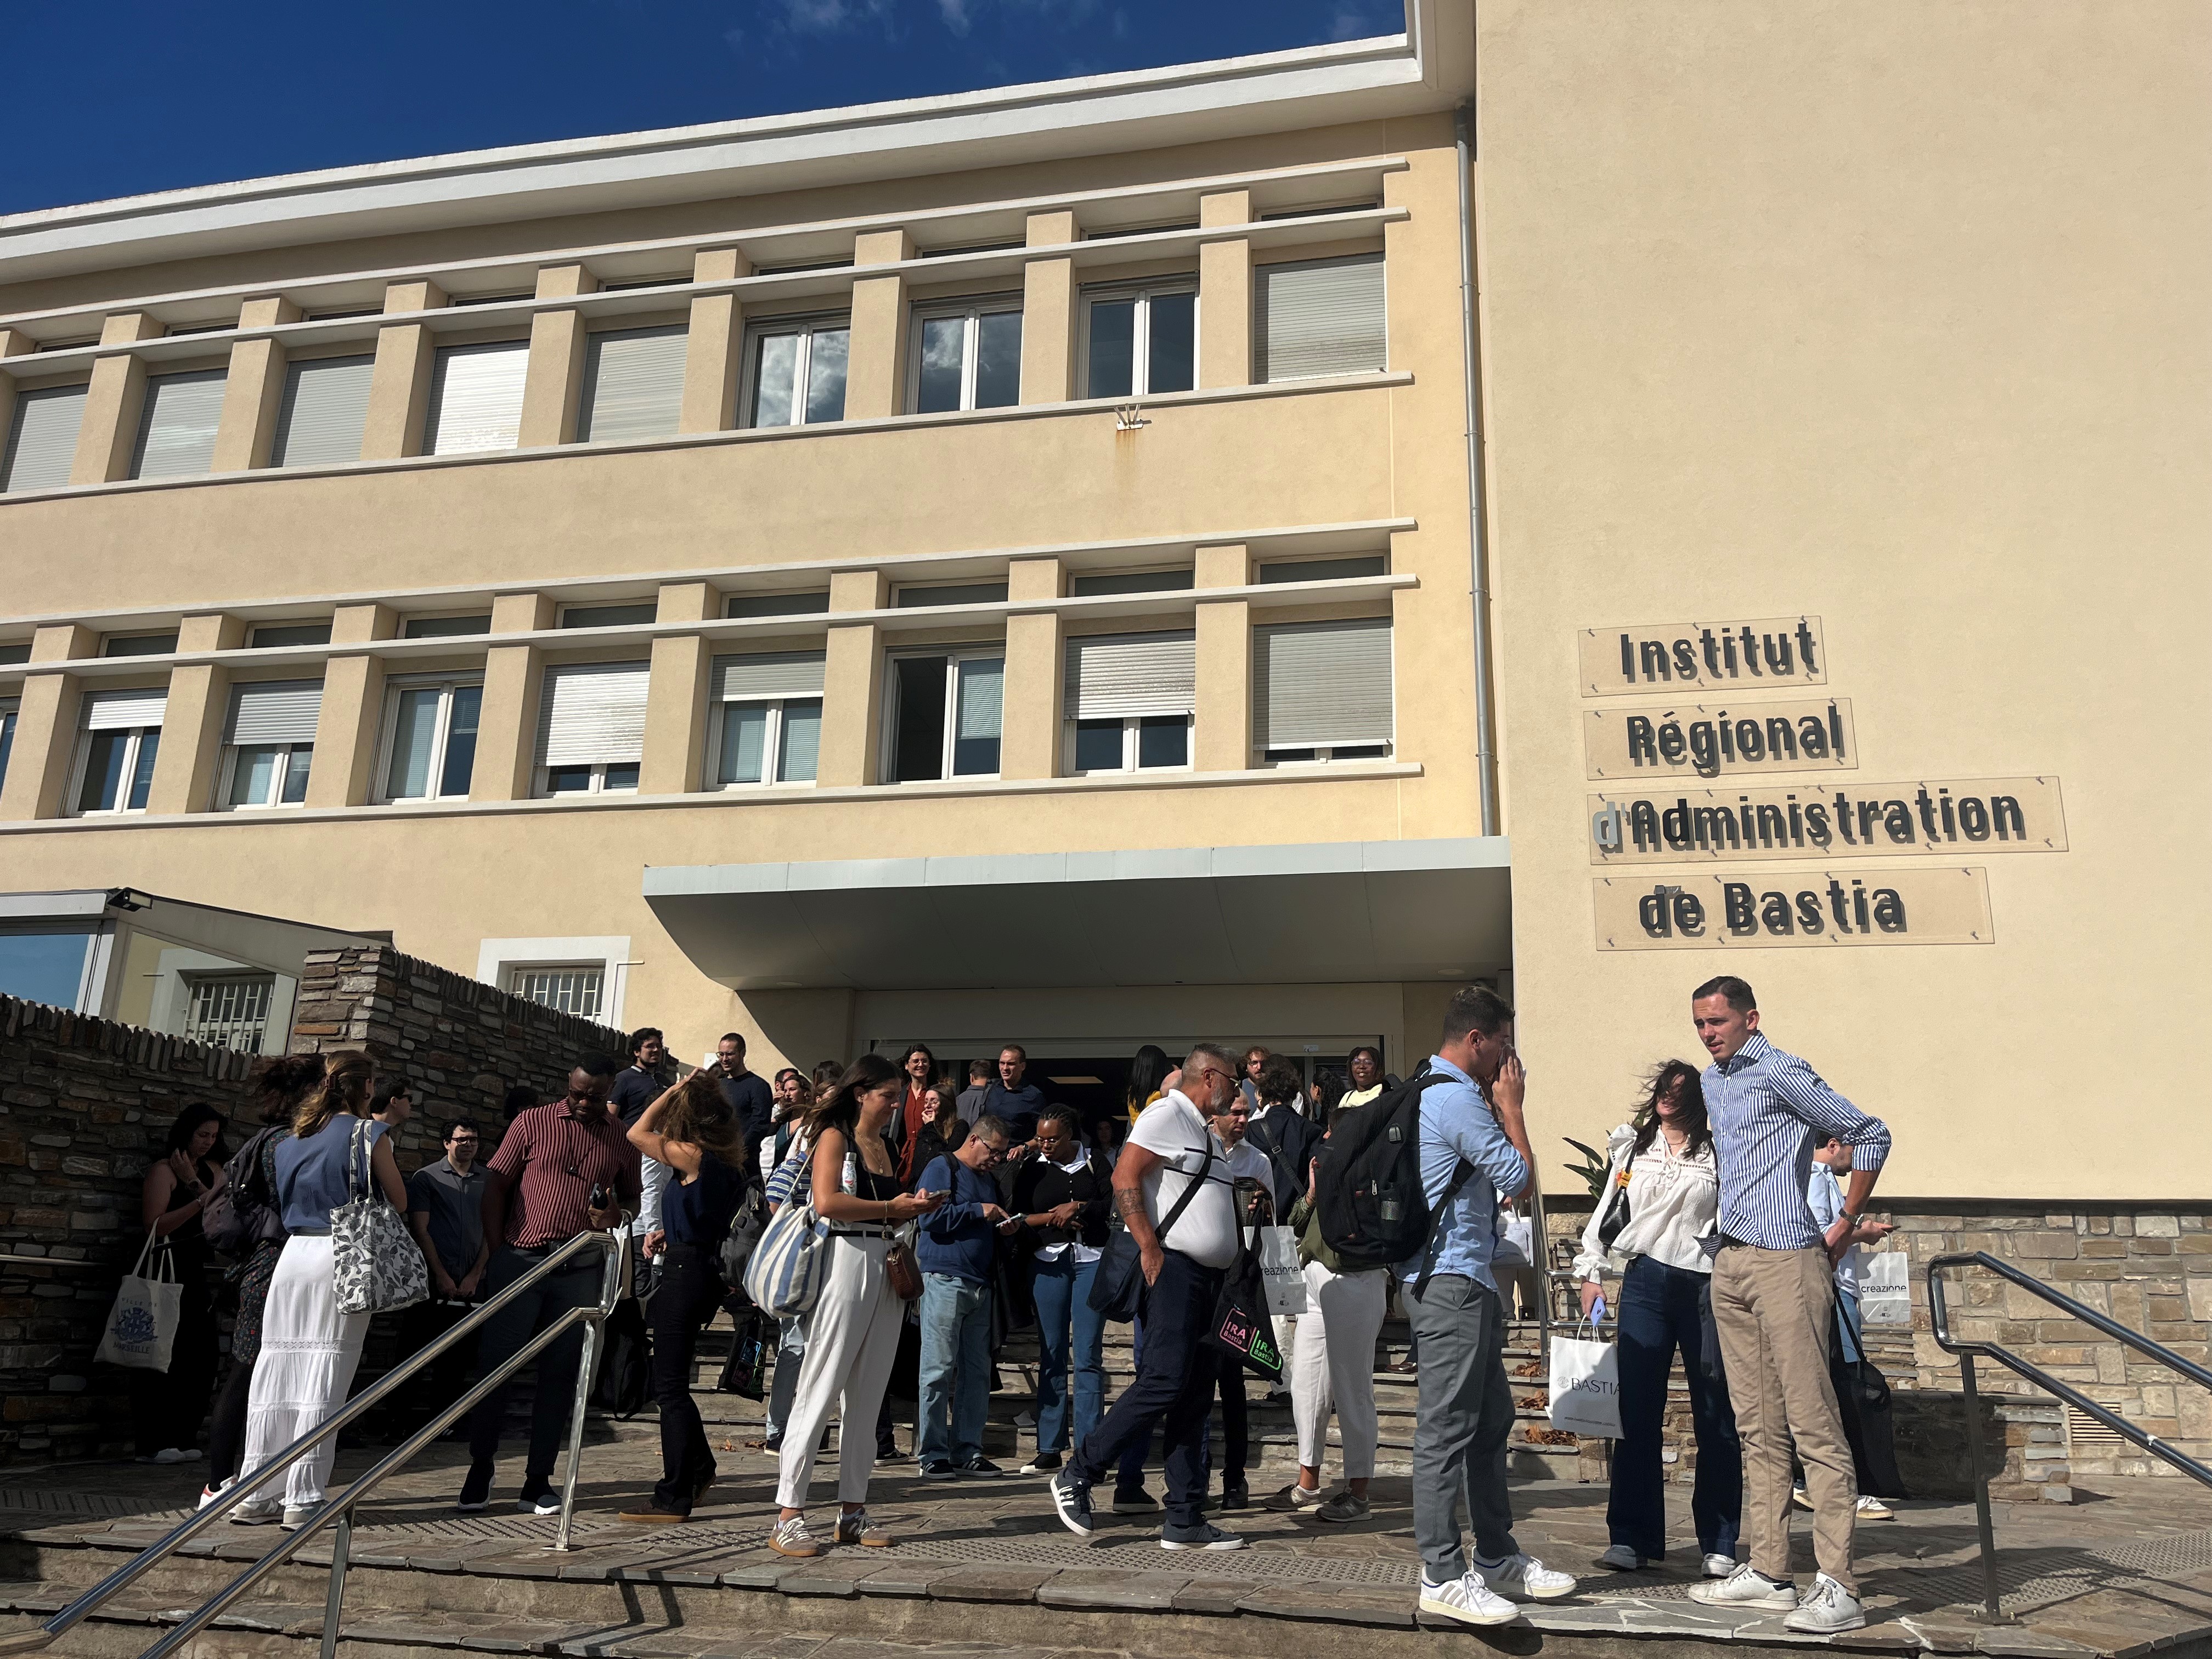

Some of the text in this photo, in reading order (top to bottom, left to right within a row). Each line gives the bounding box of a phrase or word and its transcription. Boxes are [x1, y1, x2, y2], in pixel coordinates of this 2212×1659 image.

[1620, 623, 1814, 675] Institut
[1626, 705, 1843, 769] Régional
[1592, 788, 2025, 846] d'Administration
[1639, 879, 1903, 930] de Bastia
[1861, 1284, 1907, 1293] creazione
[1223, 1330, 1242, 1345] Bastia
[1226, 1322, 1246, 1339] IRA
[1254, 1349, 1273, 1362] Bastia
[1256, 1340, 1274, 1357] IRA
[1571, 1378, 1620, 1395] BASTIA
